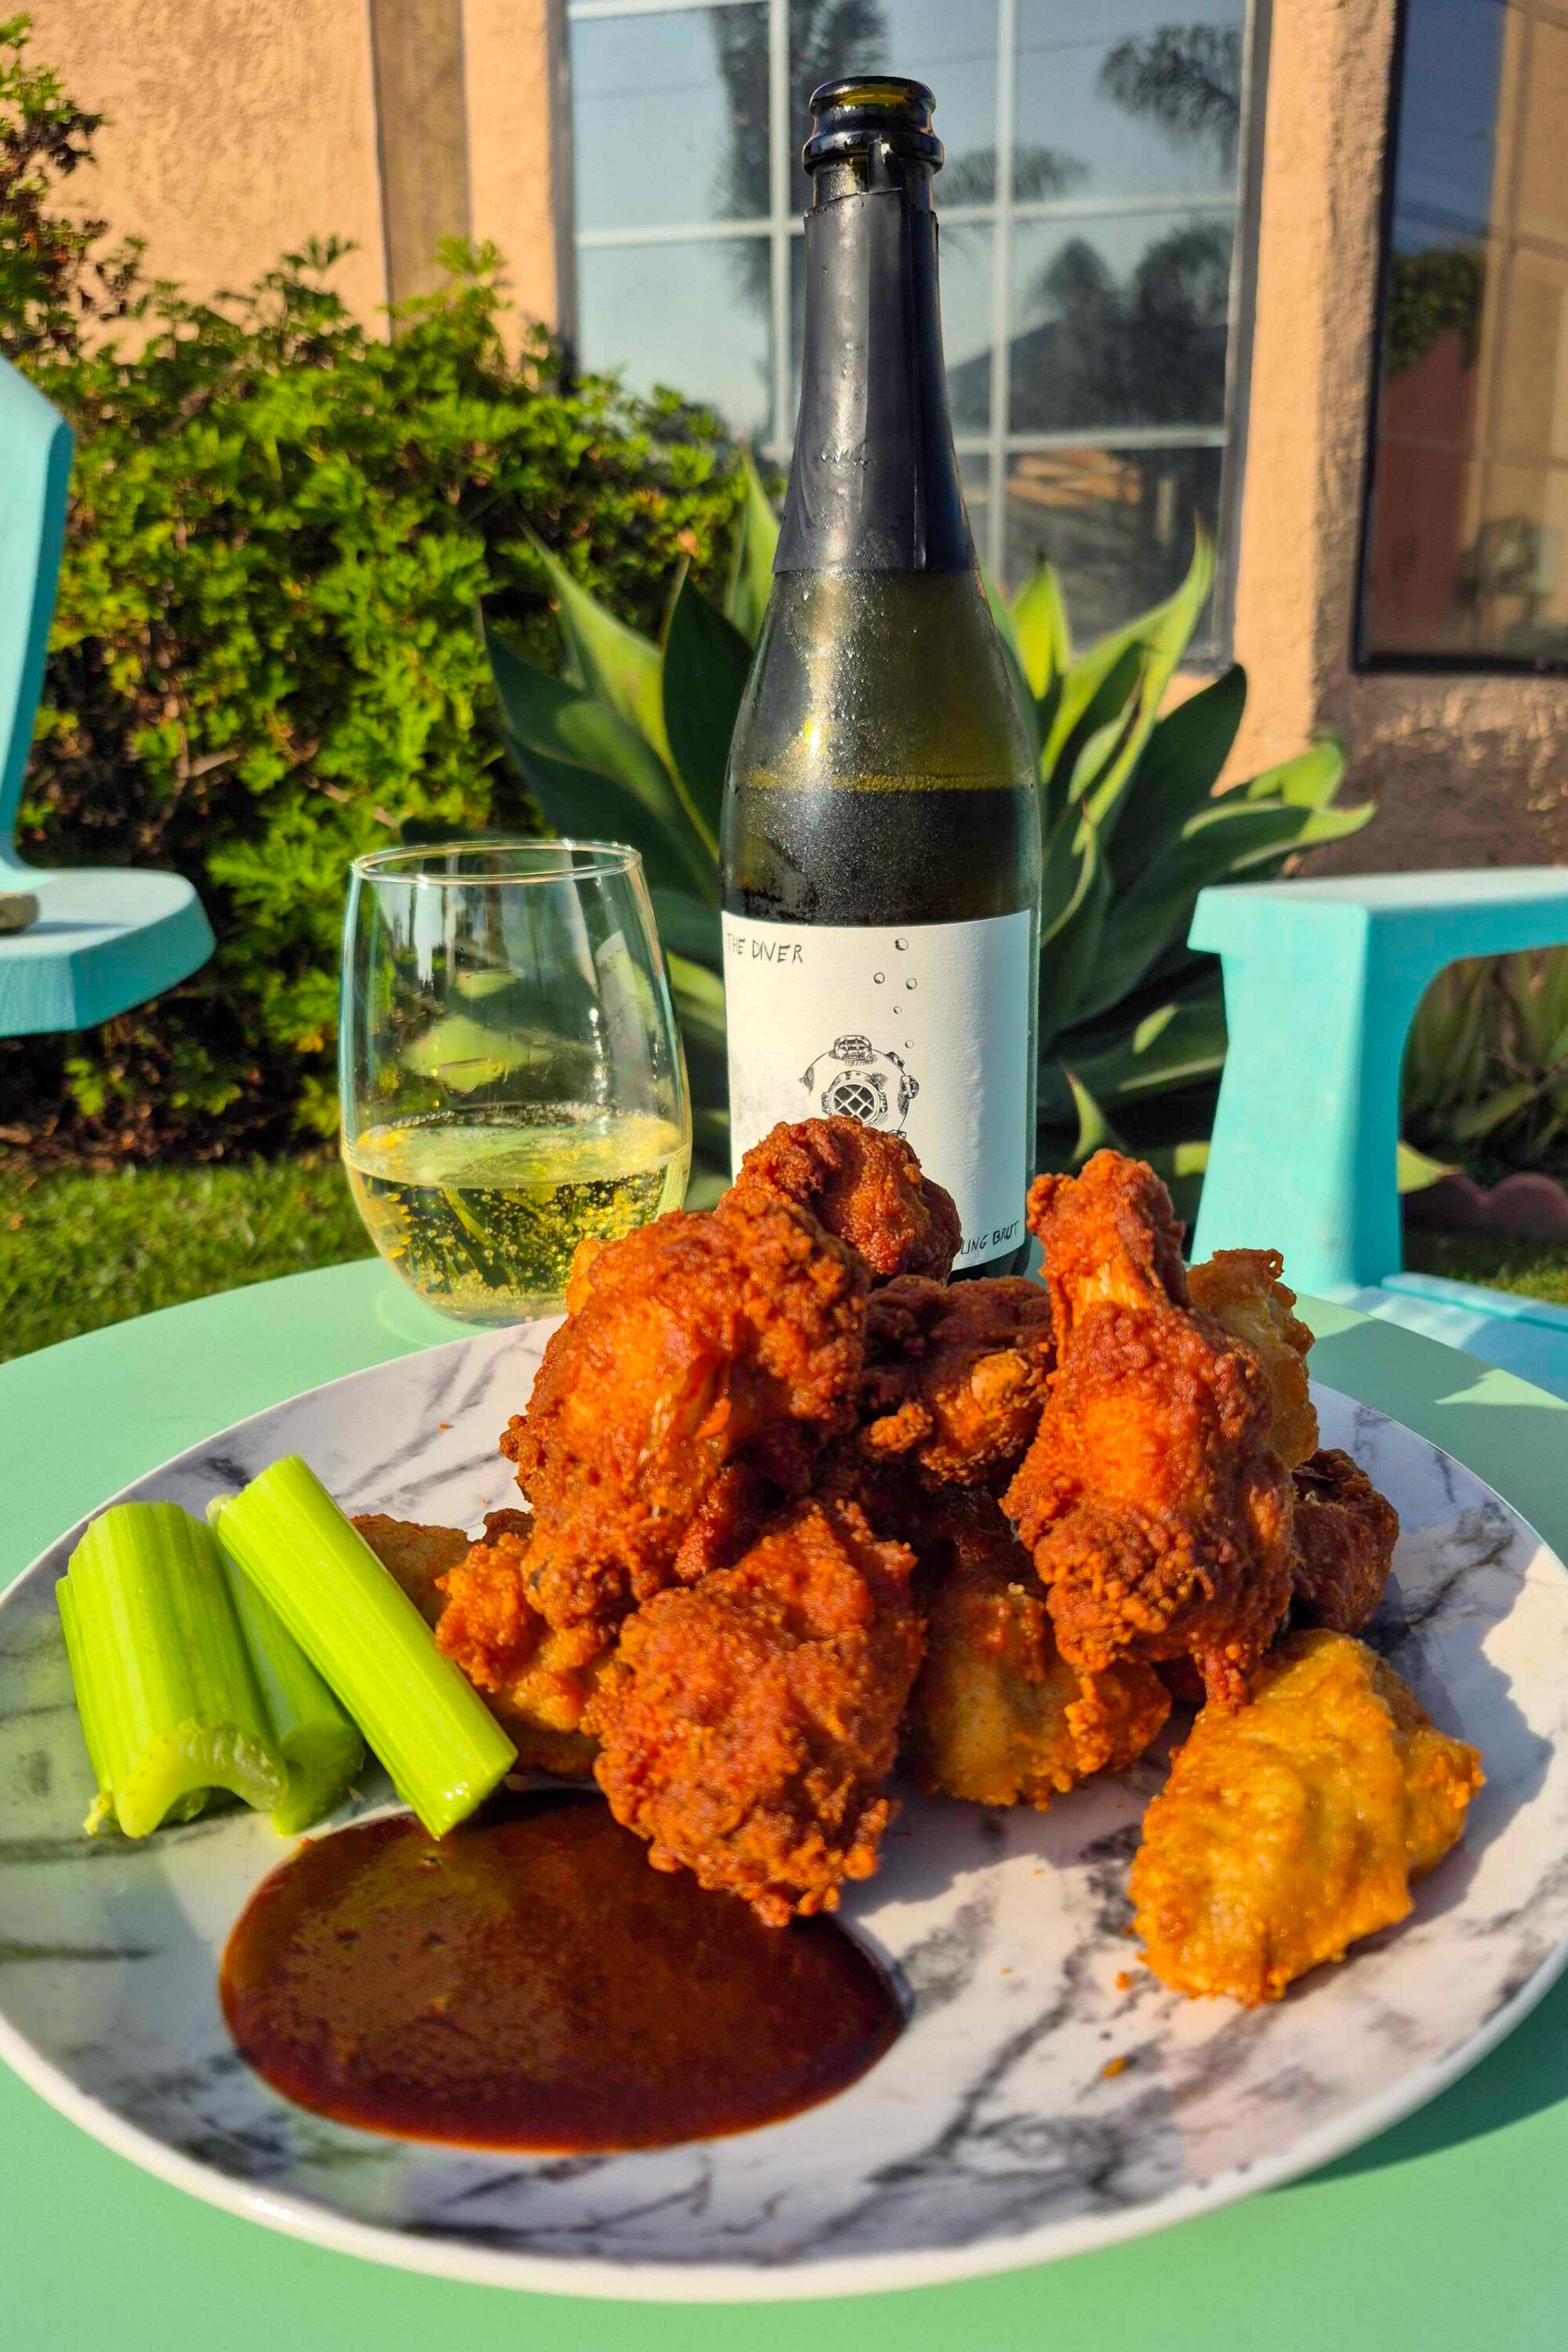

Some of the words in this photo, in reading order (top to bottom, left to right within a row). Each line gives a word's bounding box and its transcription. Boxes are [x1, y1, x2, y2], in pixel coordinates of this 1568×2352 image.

[727, 933, 746, 955] THE
[752, 939, 803, 964] DIVER
[960, 1234, 988, 1254] LING
[992, 1220, 1019, 1245] BRUT
